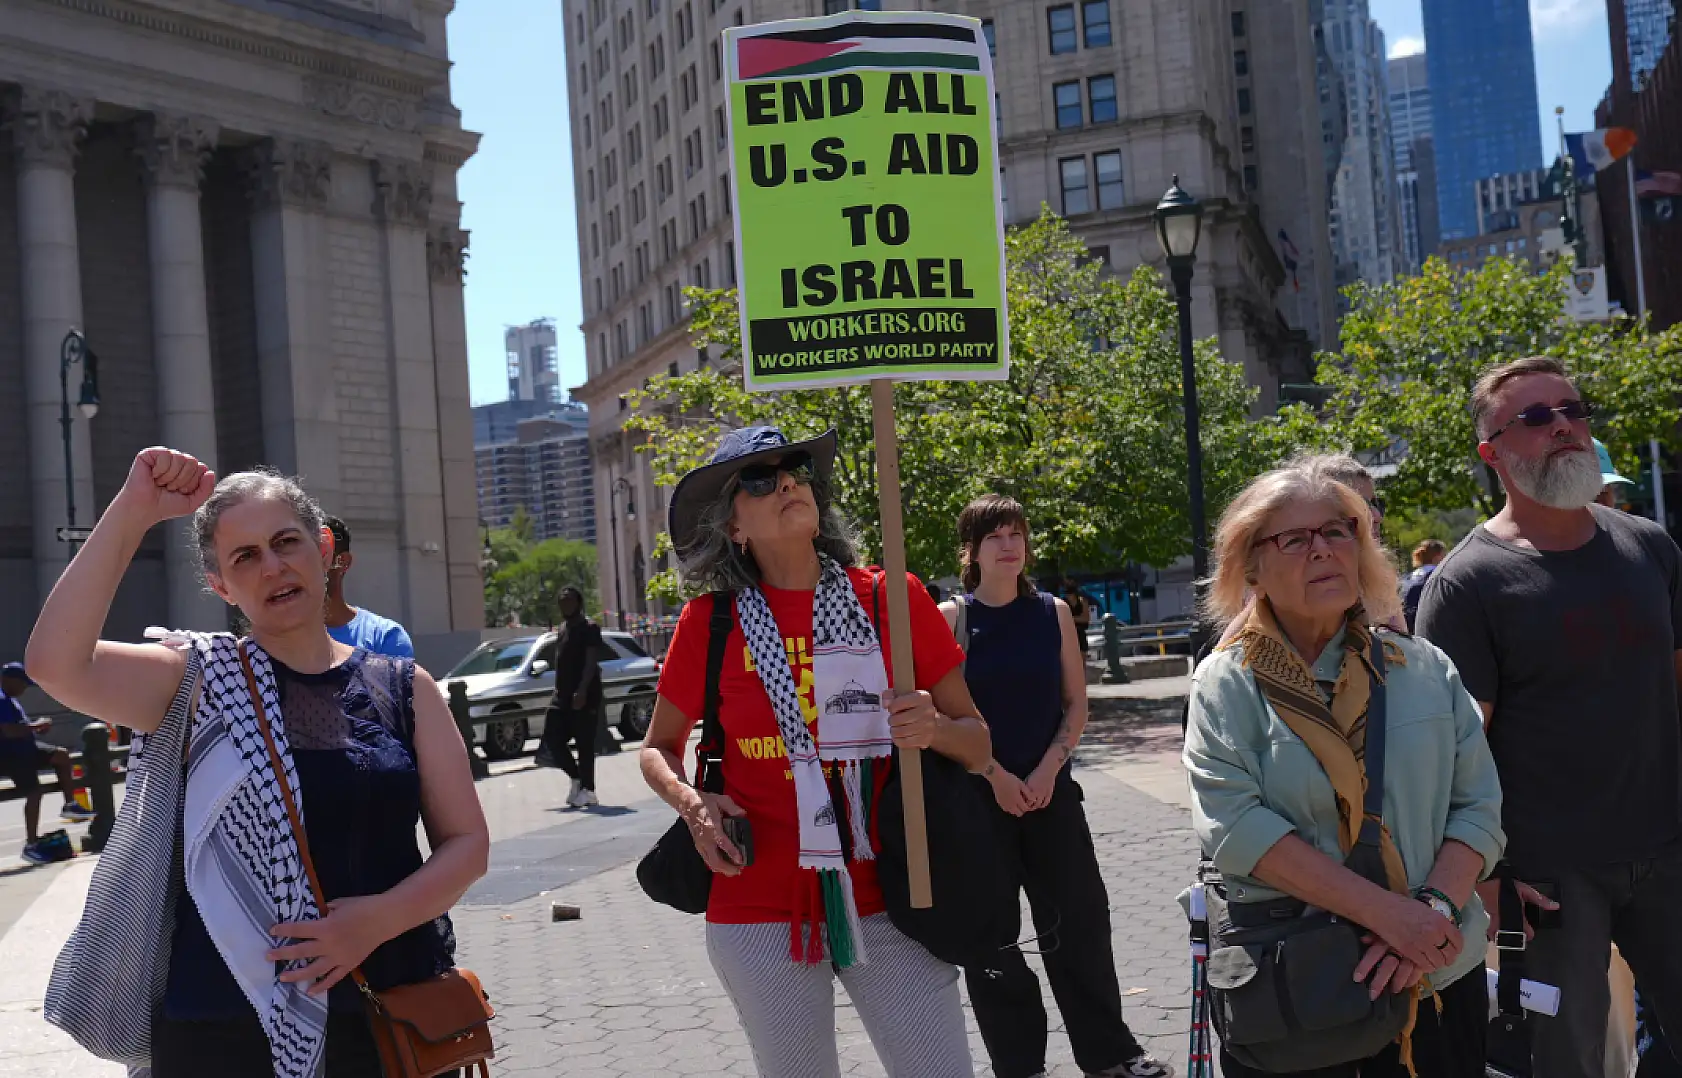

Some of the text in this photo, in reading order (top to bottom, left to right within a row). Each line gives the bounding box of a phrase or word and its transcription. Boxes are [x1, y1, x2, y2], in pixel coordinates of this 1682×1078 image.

[744, 73, 977, 127] END ALL
[749, 133, 979, 188] U.S. AID
[842, 204, 910, 248] TO
[780, 258, 974, 309] ISRAEL
[788, 312, 966, 342] WORKERS.ORG
[758, 342, 995, 369] WORKERS WORLD PARTY
